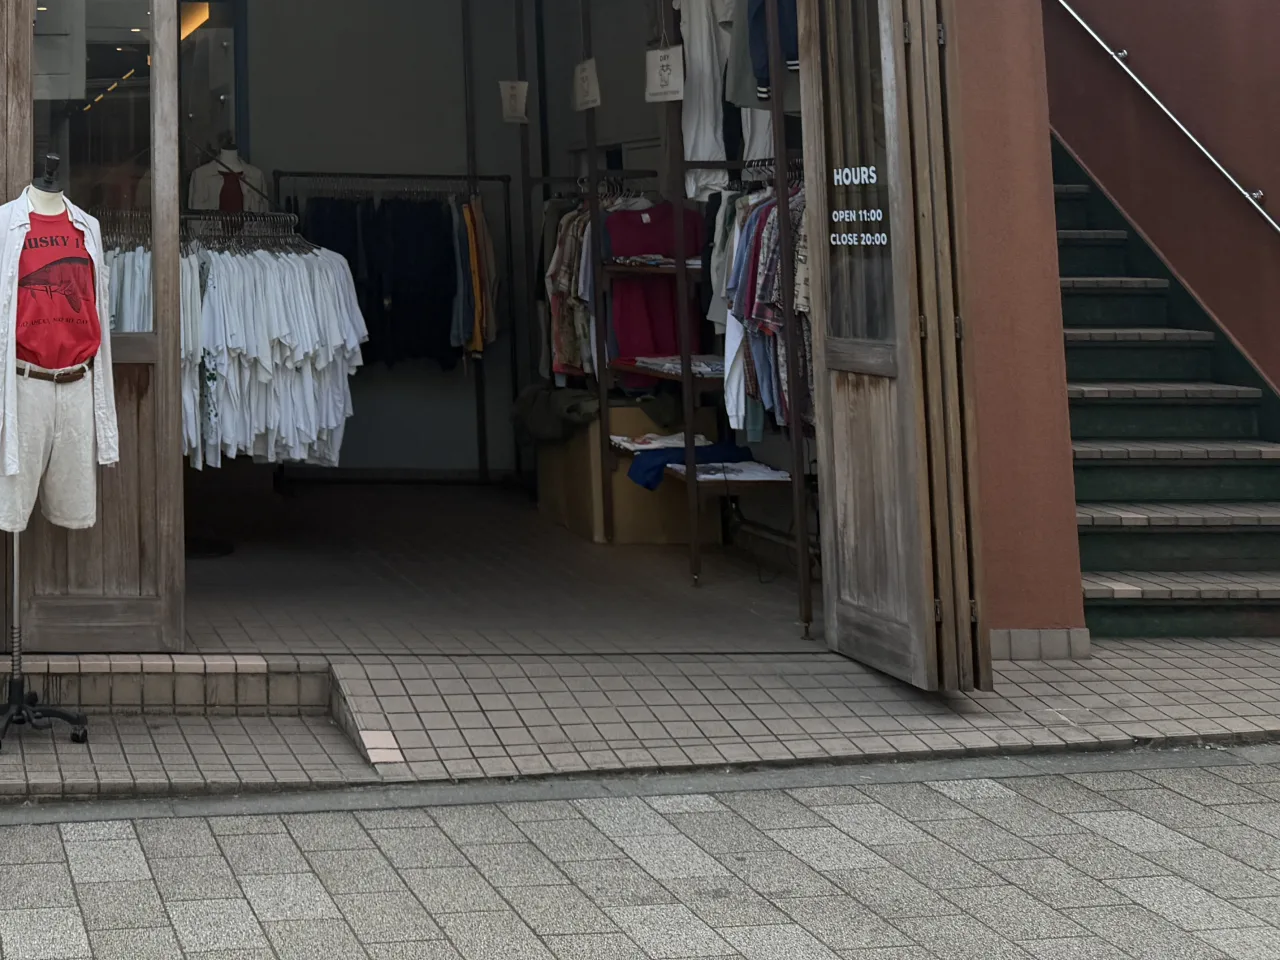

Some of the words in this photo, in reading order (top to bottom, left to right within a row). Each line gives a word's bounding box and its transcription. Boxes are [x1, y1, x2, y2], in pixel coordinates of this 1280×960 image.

[833, 166, 877, 186] HOURS
[832, 210, 856, 222] OPEN
[858, 209, 883, 221] 11:00
[830, 233, 859, 245] CLOSE
[860, 233, 887, 245] 20:00
